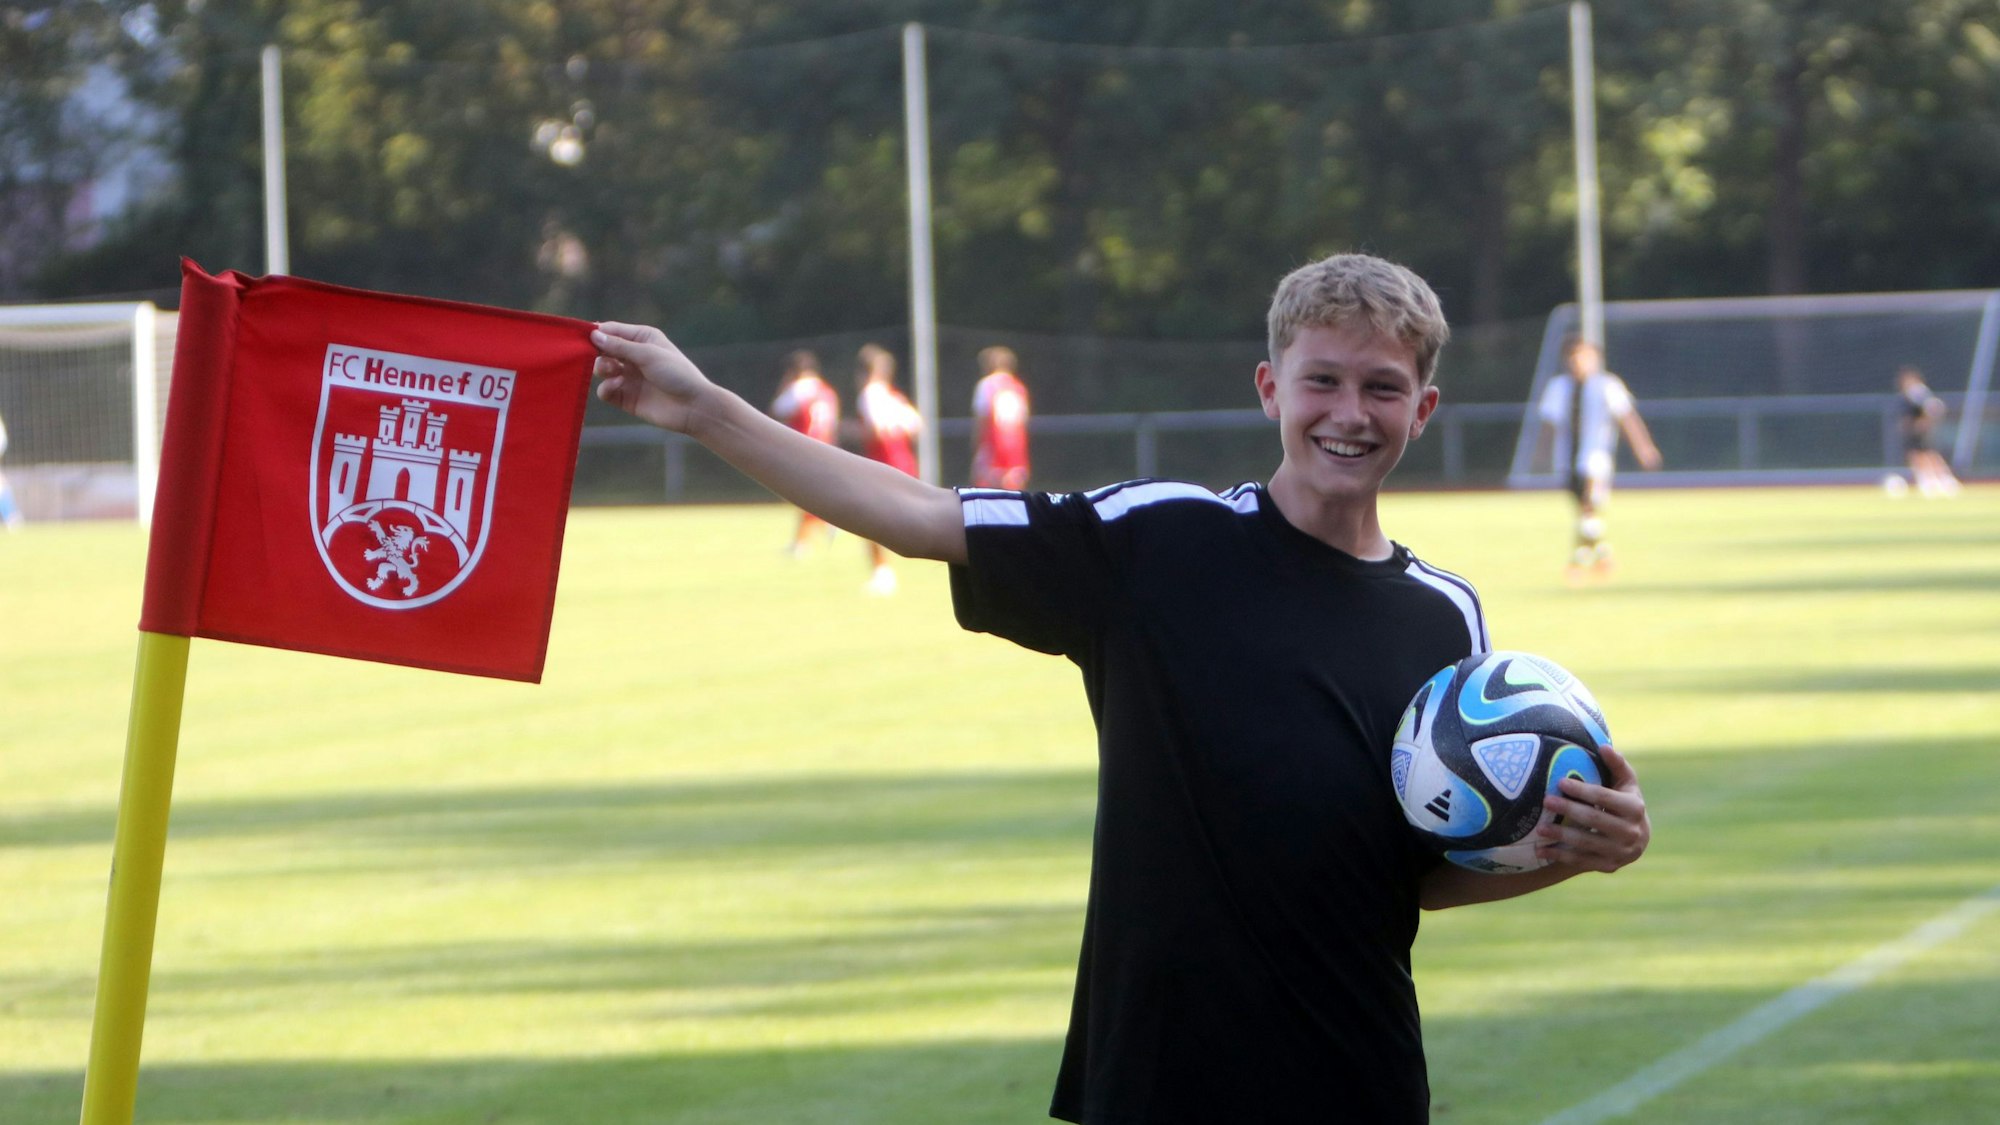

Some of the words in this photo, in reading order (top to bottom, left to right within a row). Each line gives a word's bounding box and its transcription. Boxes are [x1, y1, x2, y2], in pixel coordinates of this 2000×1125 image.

[328, 352, 359, 380] FC
[363, 357, 472, 395] Hennef
[479, 374, 510, 401] 05
